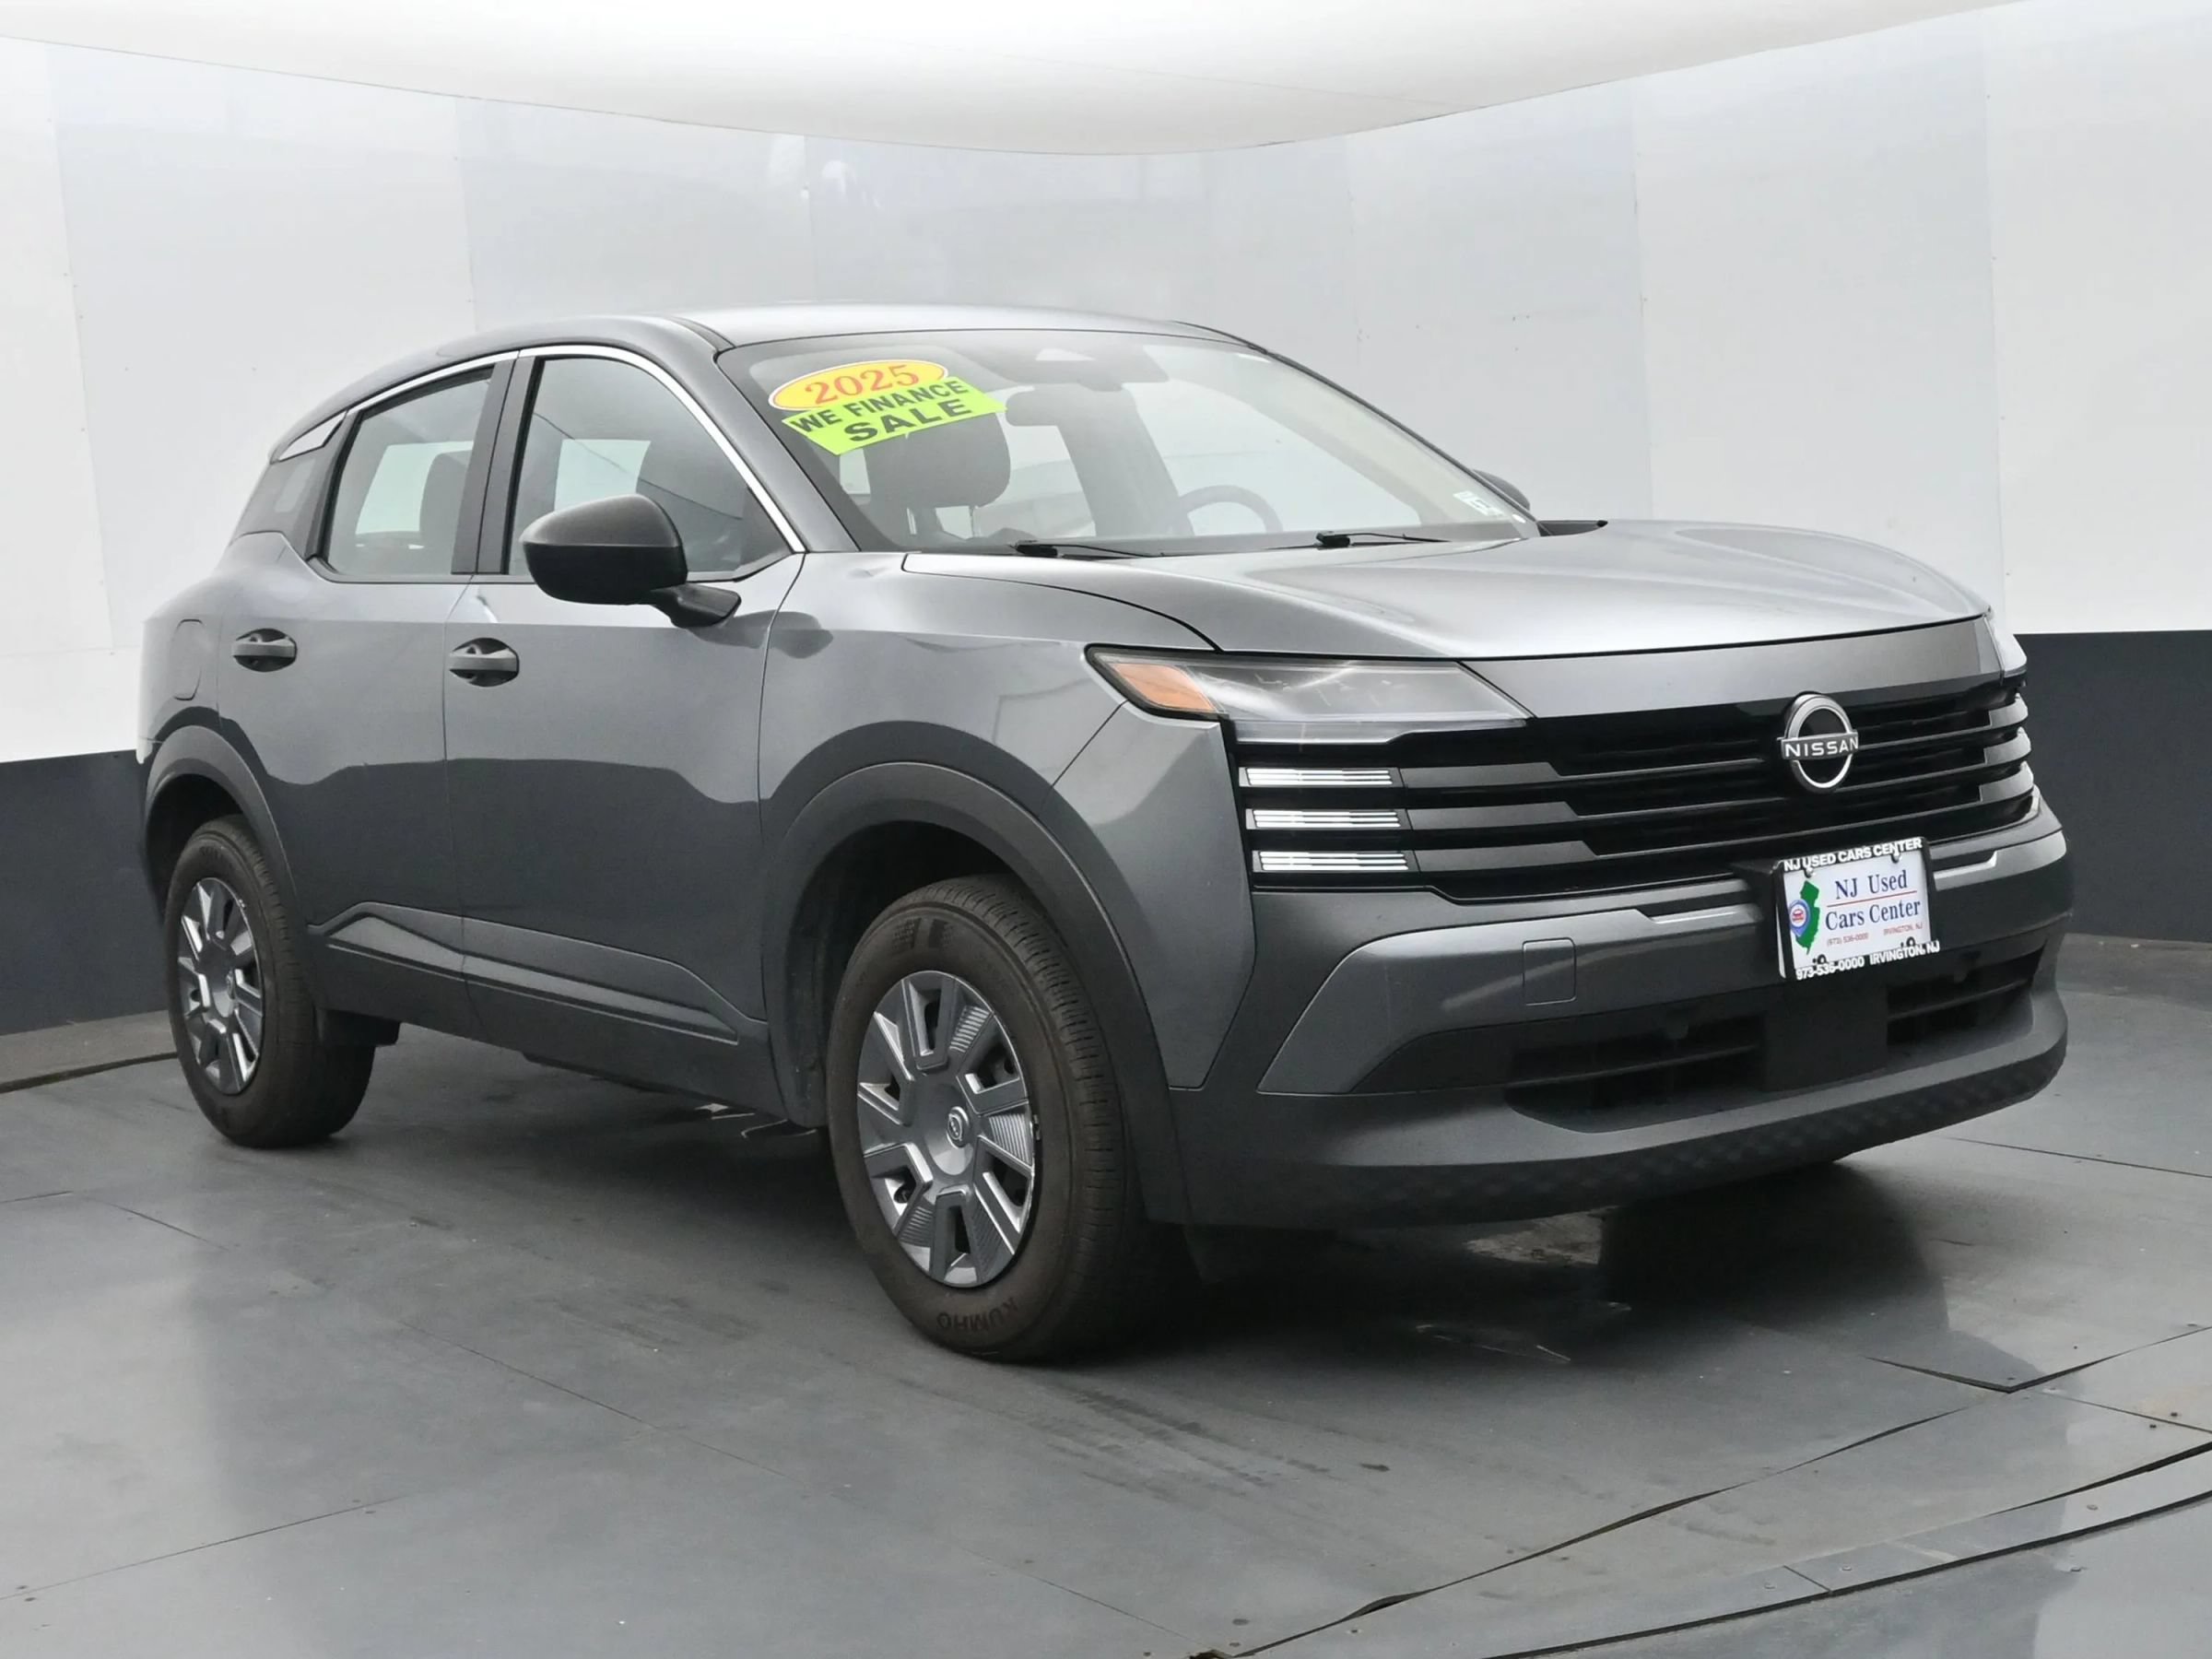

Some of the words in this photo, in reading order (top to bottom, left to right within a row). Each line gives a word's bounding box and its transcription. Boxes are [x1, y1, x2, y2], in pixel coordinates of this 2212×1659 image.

[806, 364, 919, 405] 2025
[790, 409, 843, 433] WE
[843, 380, 969, 417] FINANCE
[844, 398, 972, 441] SALE
[1784, 735, 1859, 758] NISSAN
[1783, 858, 1801, 872] NJ
[1802, 853, 1836, 869] USED
[1838, 847, 1872, 863] CARS
[1872, 837, 1923, 857] CENTER
[1835, 877, 1858, 900] NJ
[1867, 869, 1908, 894] Used
[1825, 911, 1865, 931] Cars
[1869, 900, 1921, 924] Center
[1926, 939, 1940, 955] NJ
[936, 1297, 1021, 1332] KUMHO
